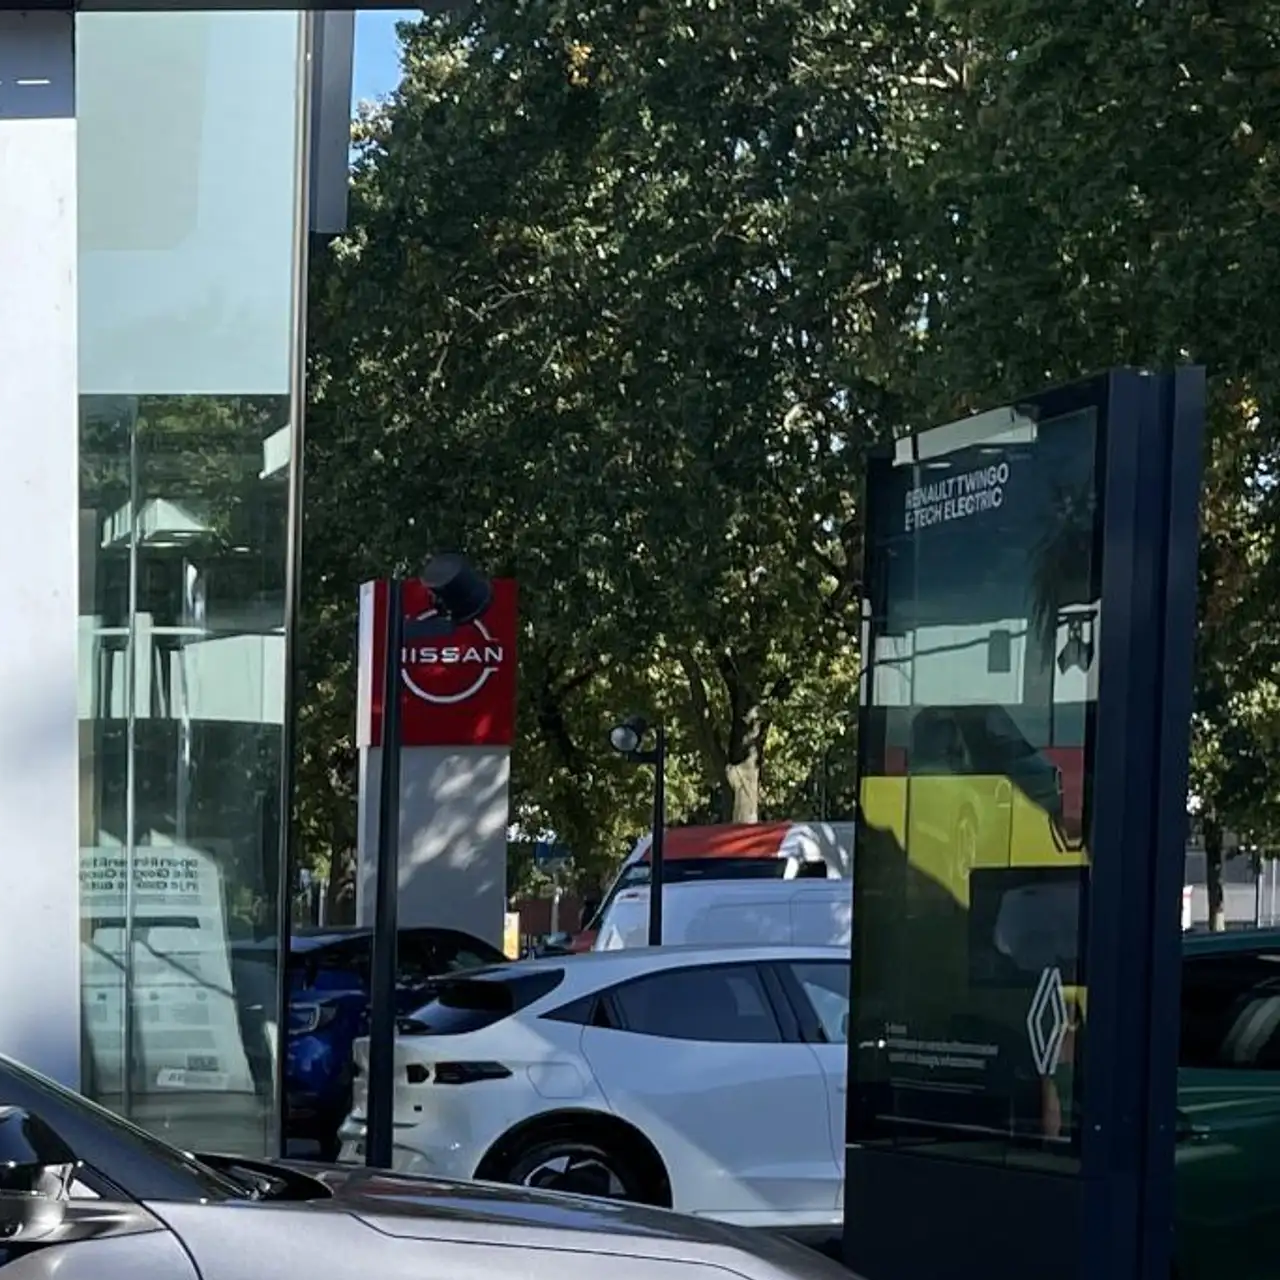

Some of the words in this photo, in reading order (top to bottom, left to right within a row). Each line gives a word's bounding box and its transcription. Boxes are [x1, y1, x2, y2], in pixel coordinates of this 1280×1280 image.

[904, 503, 943, 532] E-TECH
[944, 487, 1003, 520] ELECTRIC
[905, 479, 955, 511] RENAULT
[956, 463, 1010, 495] TWINGO
